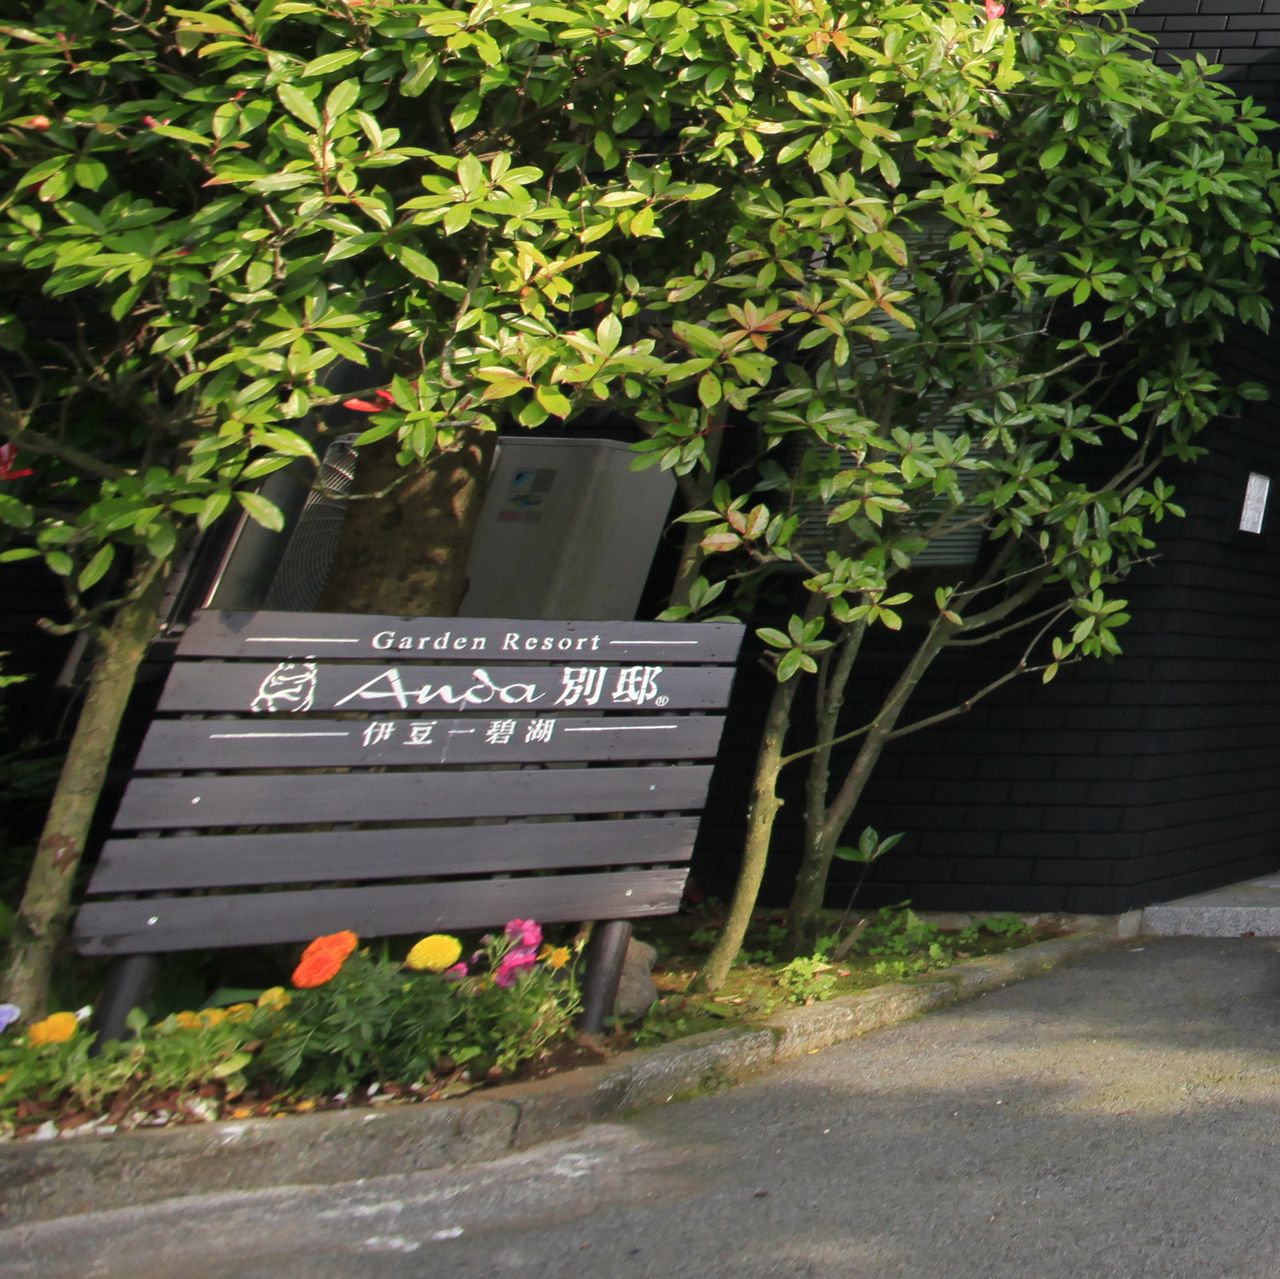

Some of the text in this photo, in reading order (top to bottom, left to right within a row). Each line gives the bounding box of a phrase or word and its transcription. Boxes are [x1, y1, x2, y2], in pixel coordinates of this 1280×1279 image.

[371, 630, 601, 650] Garden Resort
[334, 668, 546, 709] Anda
[362, 719, 556, 747] 伊豆一碧湖
